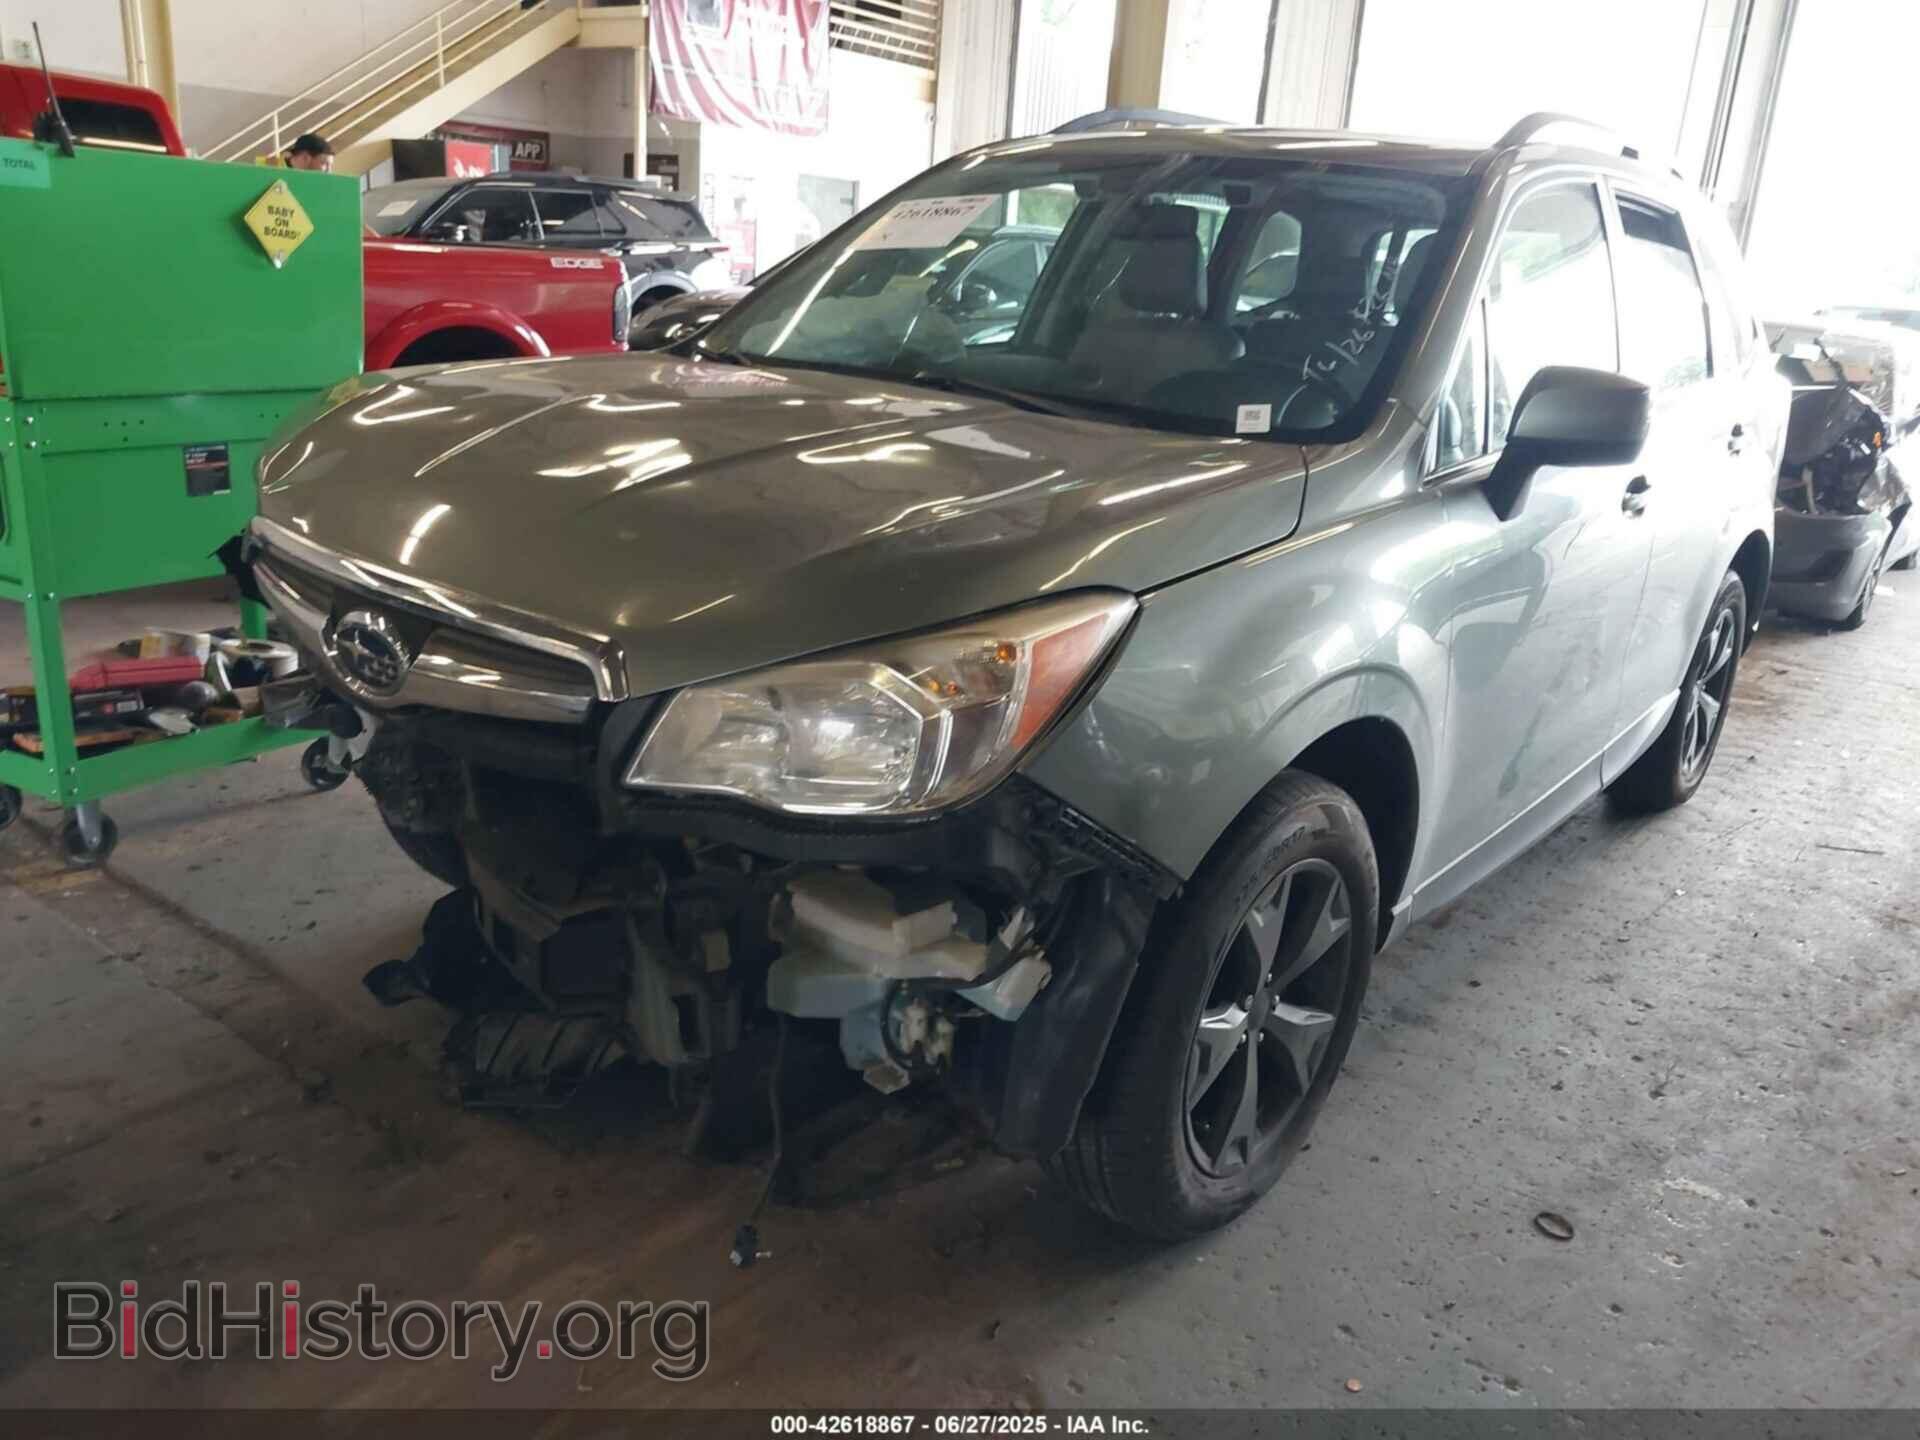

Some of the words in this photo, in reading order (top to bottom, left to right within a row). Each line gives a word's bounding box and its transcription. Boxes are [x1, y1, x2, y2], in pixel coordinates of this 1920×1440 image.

[515, 142, 541, 159] APP
[267, 205, 295, 218] BABY
[275, 217, 289, 228] ON
